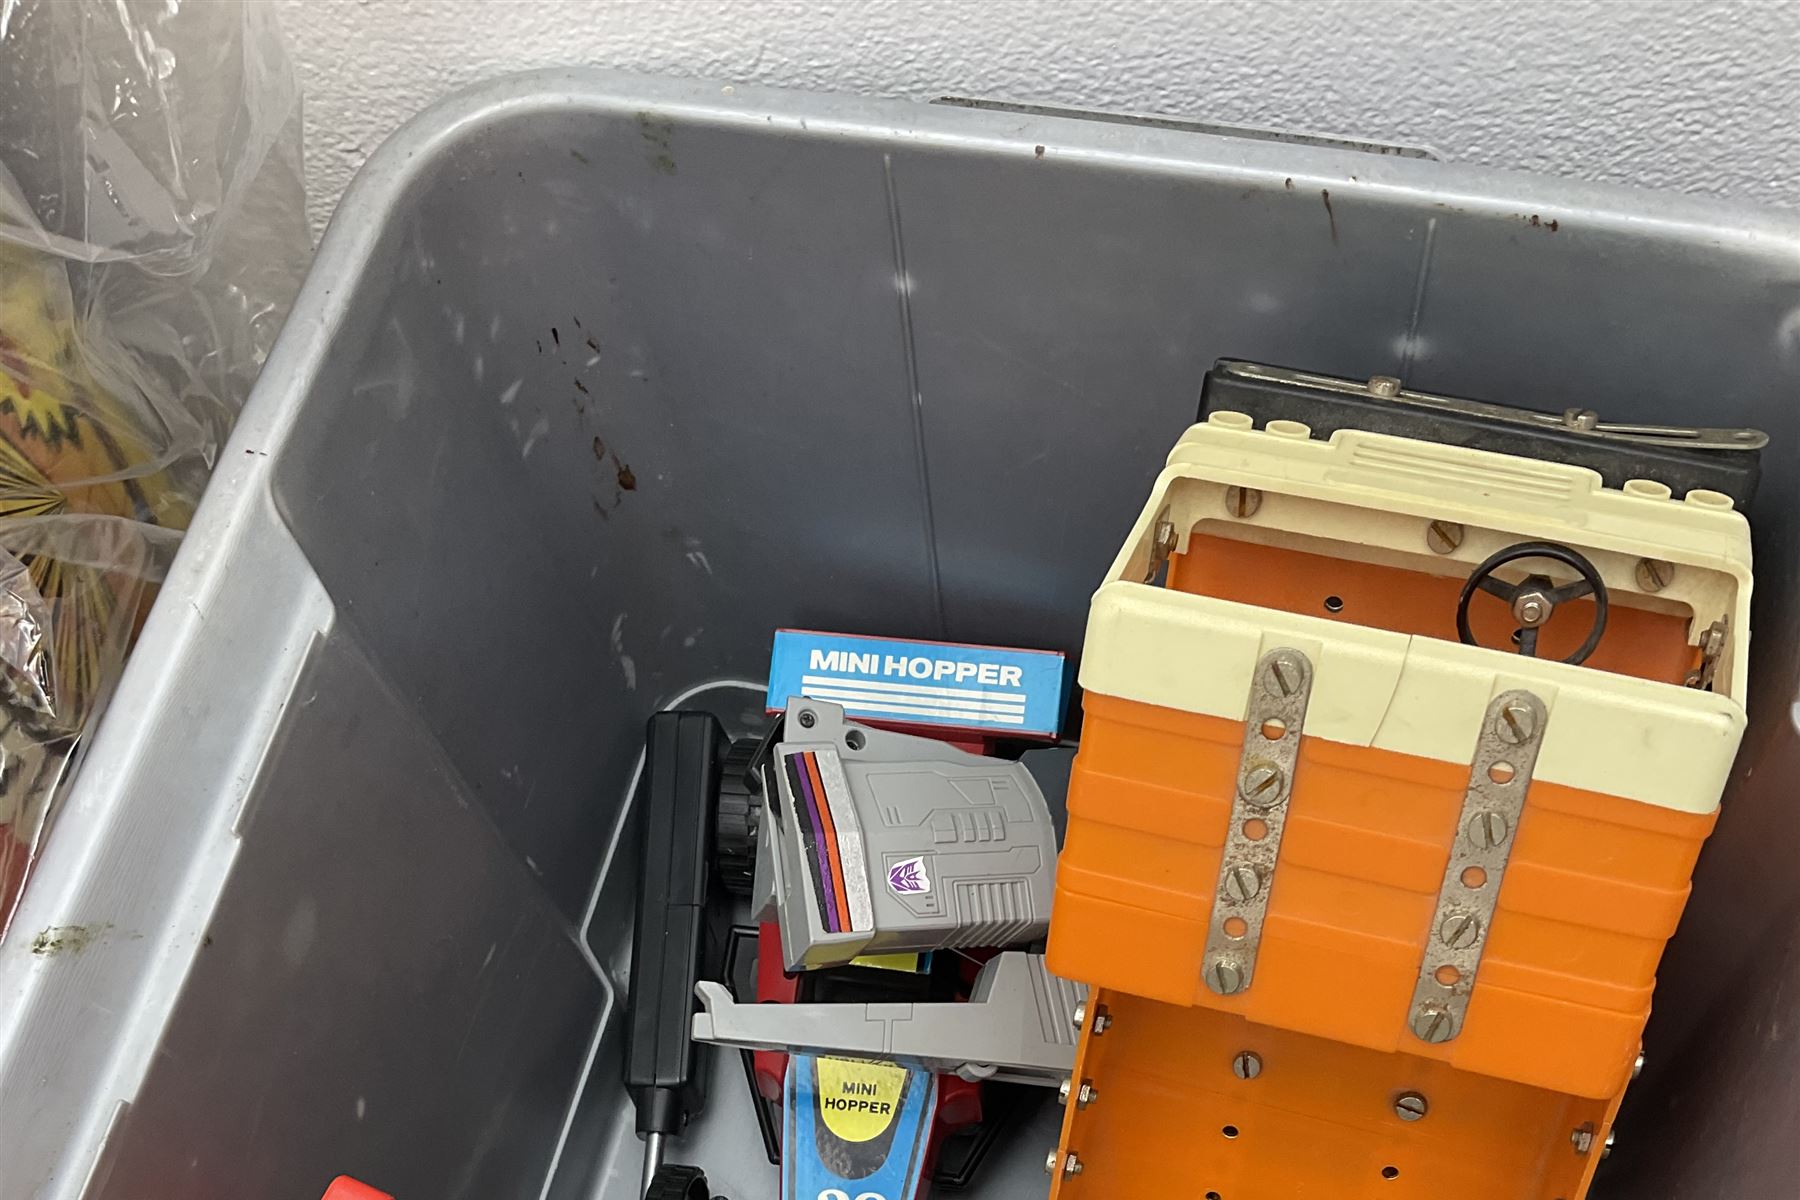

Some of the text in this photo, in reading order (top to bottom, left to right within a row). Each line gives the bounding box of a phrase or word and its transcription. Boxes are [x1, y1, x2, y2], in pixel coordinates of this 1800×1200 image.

[809, 649, 1022, 686] MINI HOPPER
[842, 1081, 877, 1096] MINI
[824, 1098, 891, 1115] HOPPER
